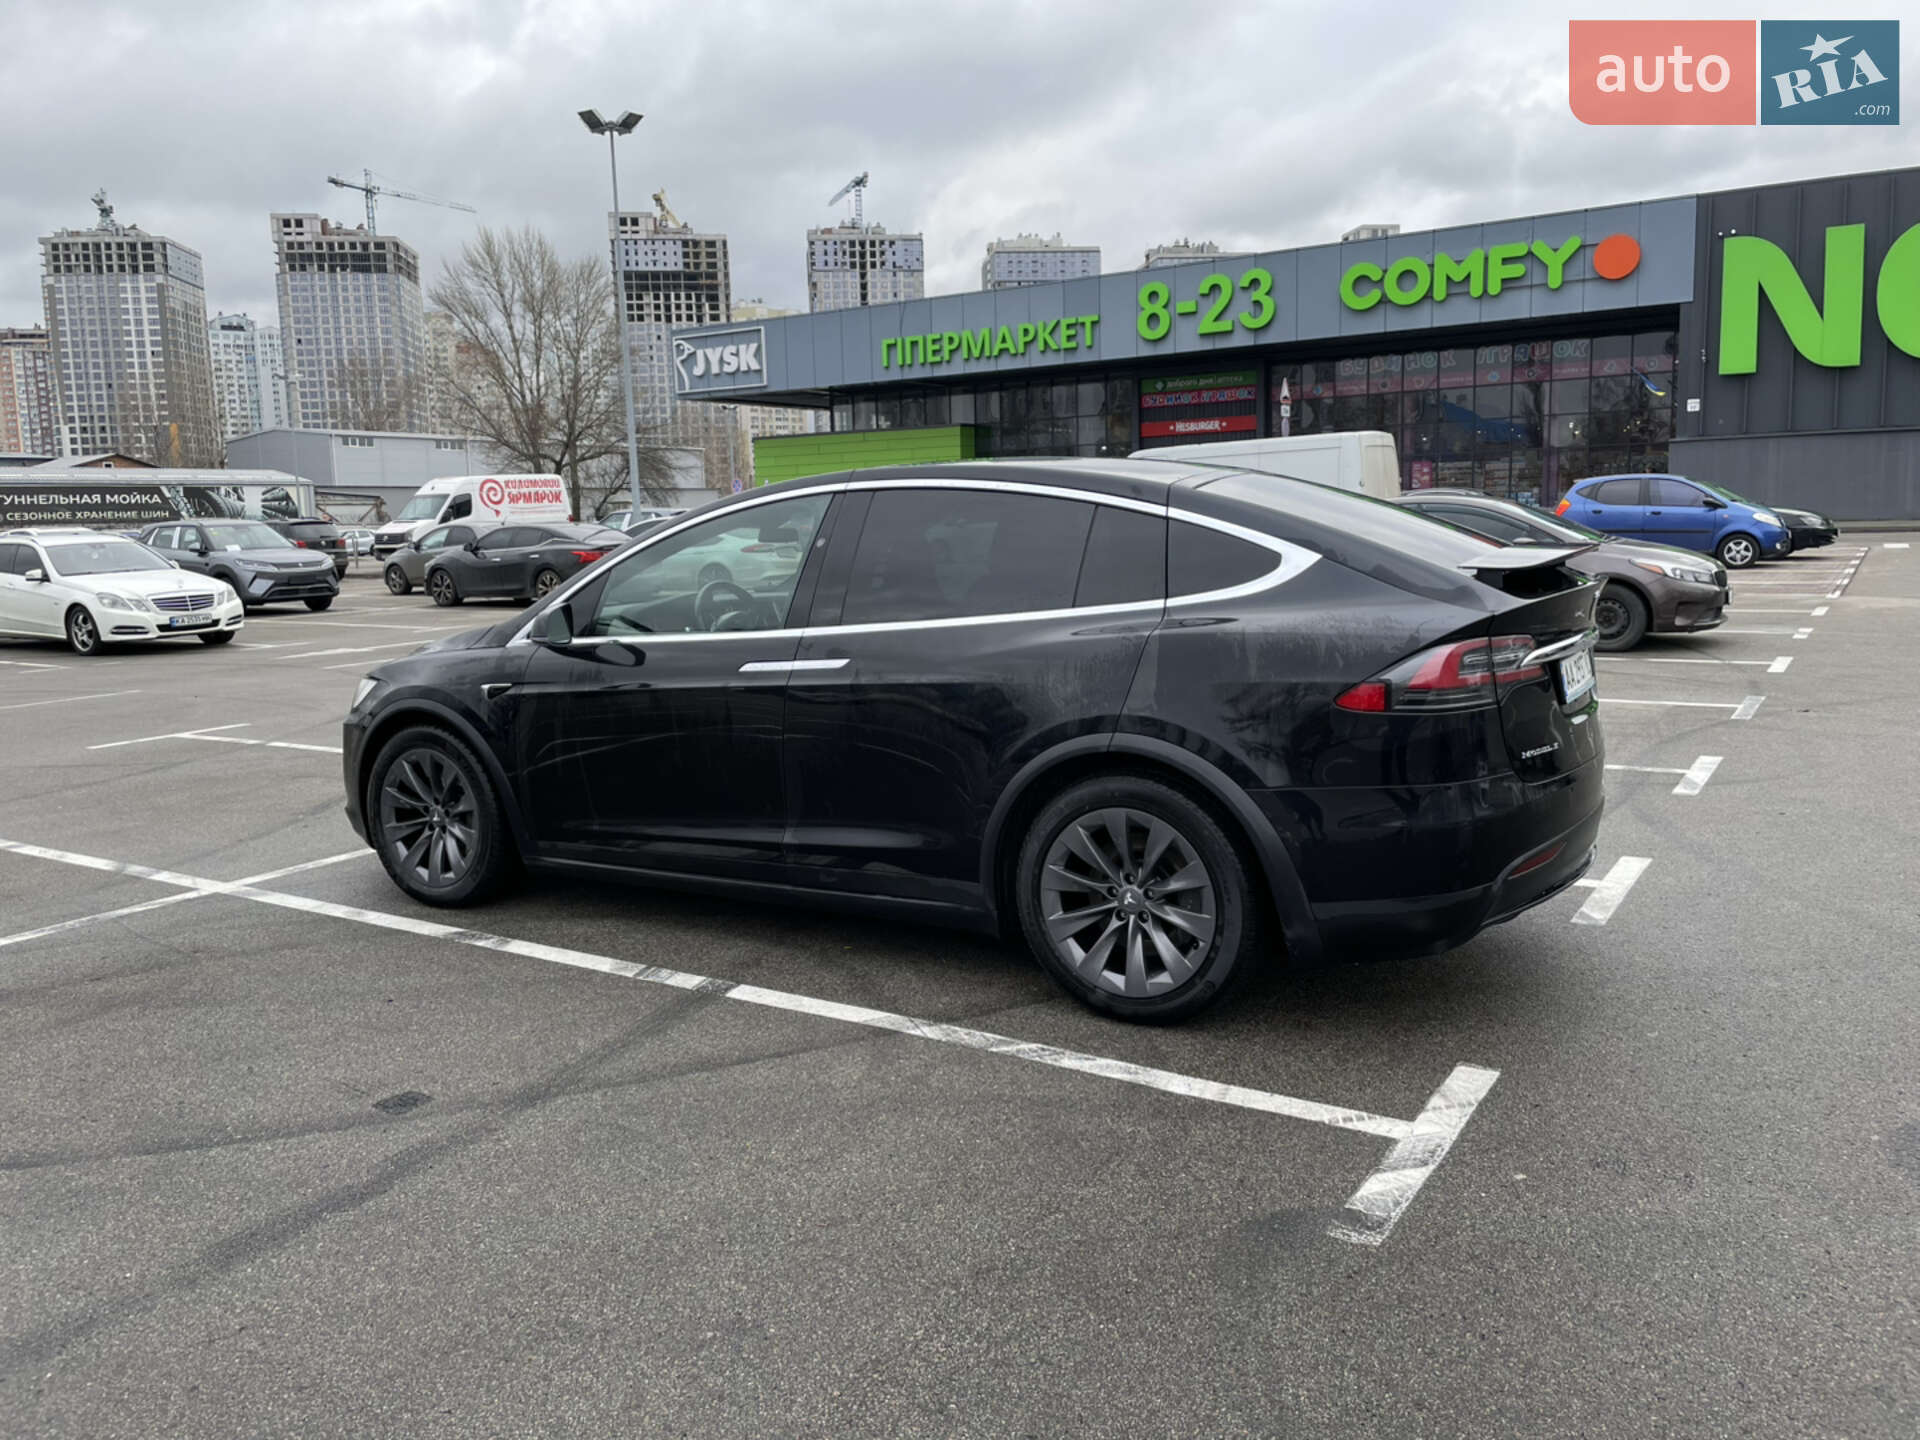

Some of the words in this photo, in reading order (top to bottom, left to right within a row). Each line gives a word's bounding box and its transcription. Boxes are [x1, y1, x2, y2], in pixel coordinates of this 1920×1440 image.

[1339, 235, 1582, 311] COMFY
[1136, 268, 1277, 341] 8-23
[880, 314, 1100, 368] ГІПЕРМАРКЕТ
[692, 342, 762, 377] JYSK
[1175, 420, 1222, 433] HESBURGER
[6, 511, 73, 521] СЕЗОННОЕ
[75, 511, 138, 520] ХРАНЕНИЕ
[141, 510, 169, 519] ШИН
[105, 491, 162, 505] МОЙКА
